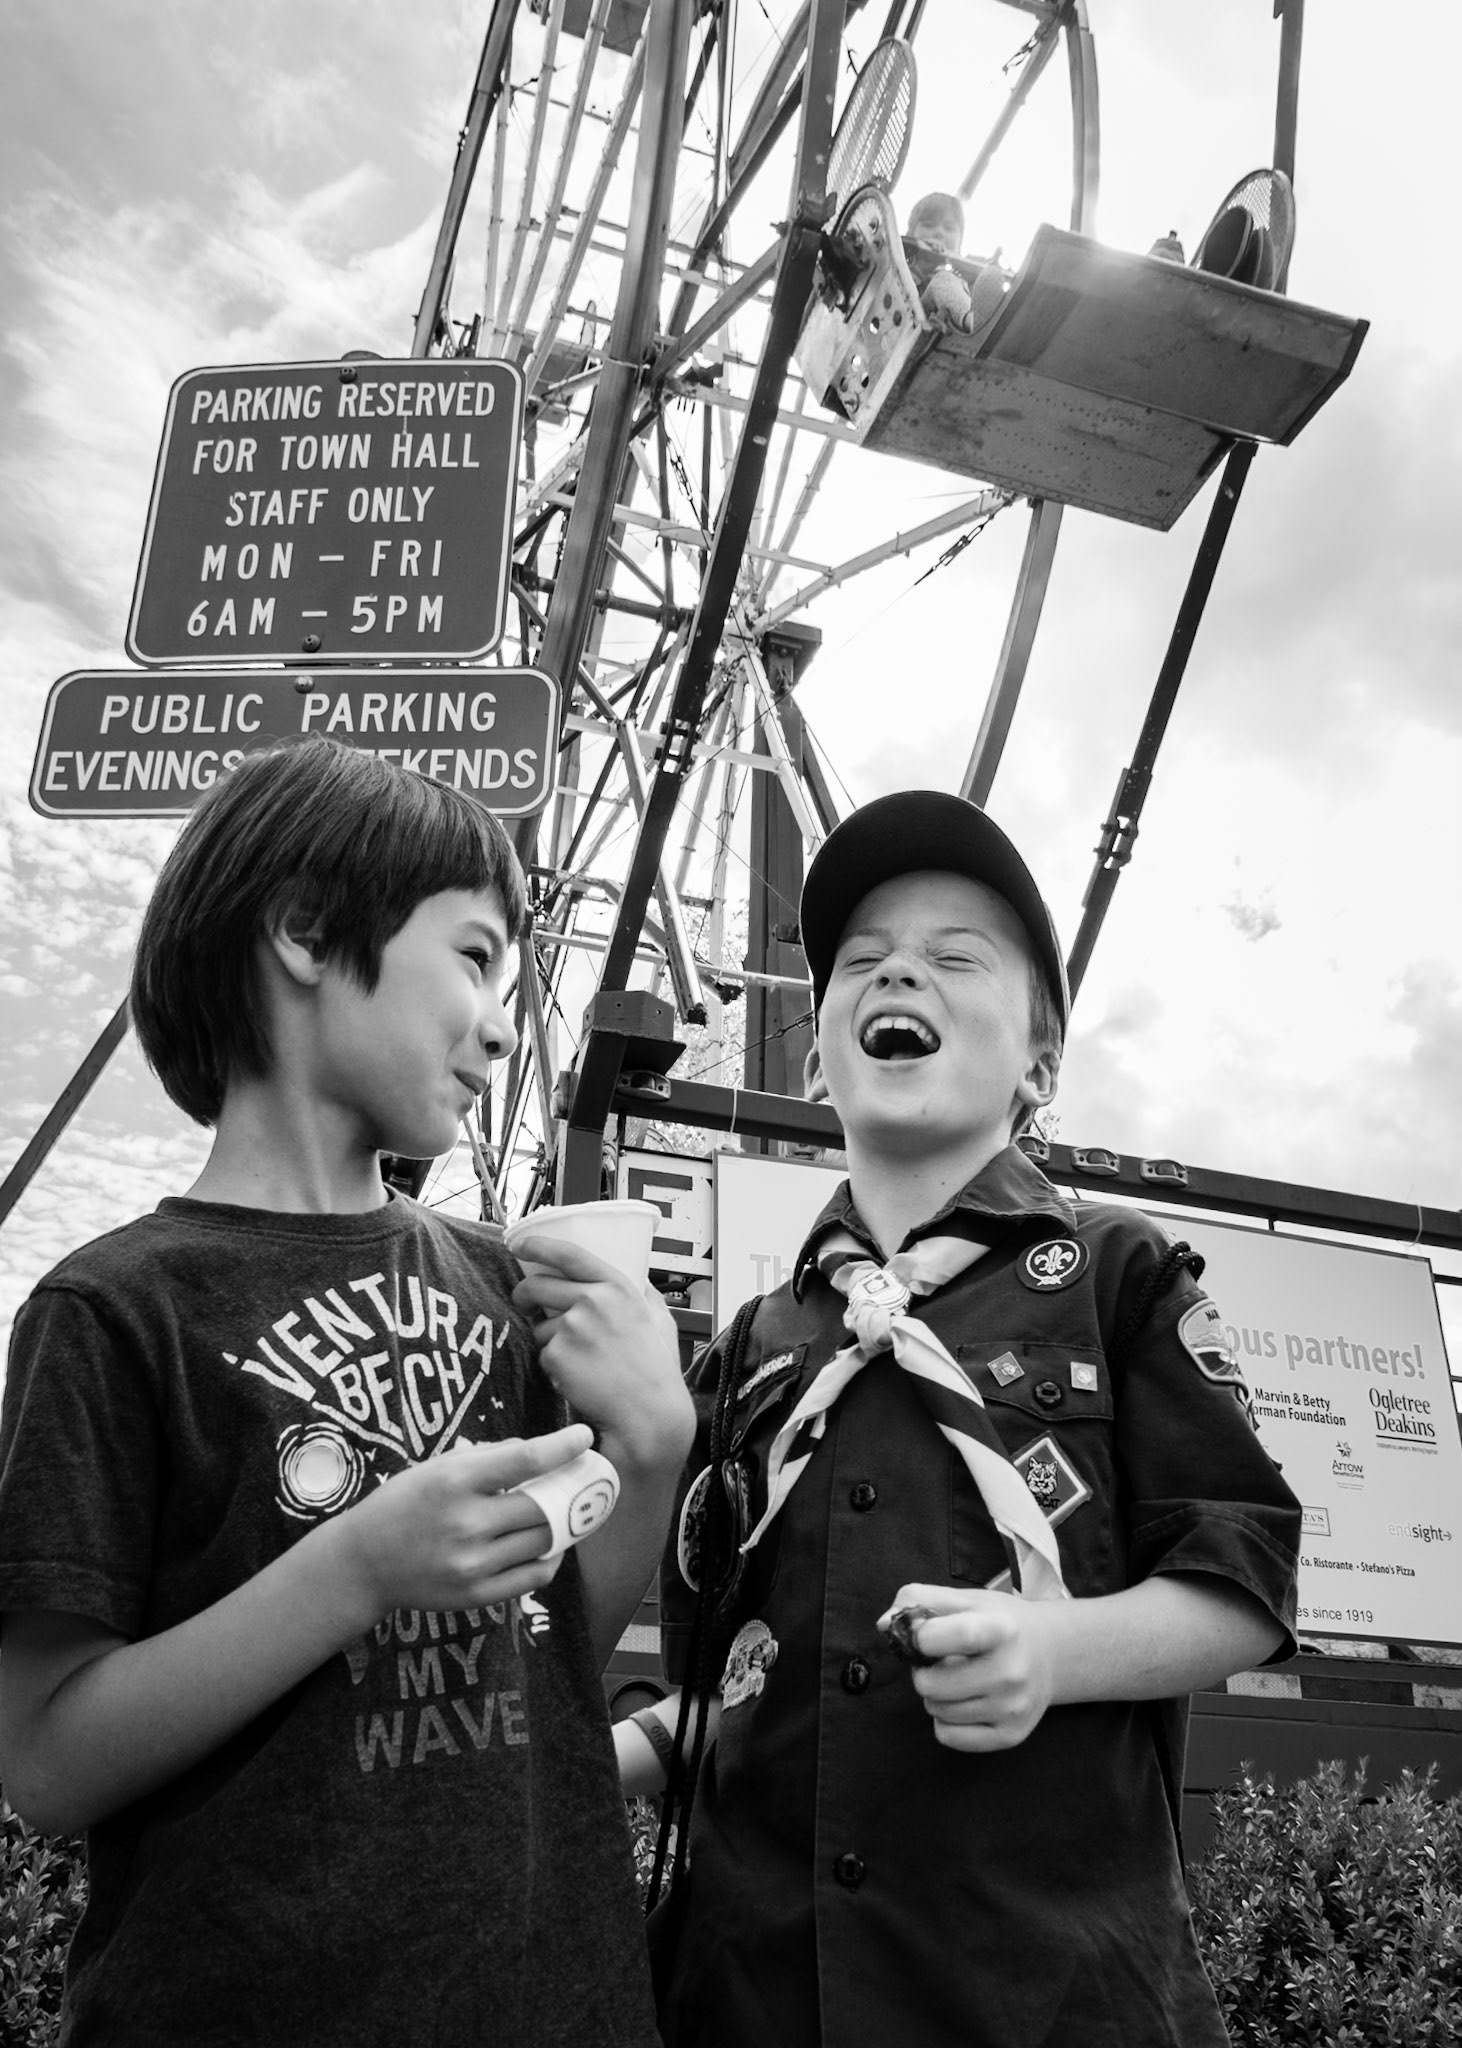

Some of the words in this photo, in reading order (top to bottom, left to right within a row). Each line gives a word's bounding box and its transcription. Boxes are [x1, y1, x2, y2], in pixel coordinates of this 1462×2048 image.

[191, 385, 323, 424] PARKING
[338, 382, 495, 417] RESERVED
[193, 438, 257, 474] FOR
[281, 434, 371, 471] TOWN
[391, 433, 480, 468] HALL
[225, 488, 329, 526] STAFF
[348, 486, 435, 523] ONLY
[201, 542, 293, 581] MON
[370, 540, 442, 577] FRI
[187, 598, 276, 637] 6AM
[350, 595, 443, 633] 5PM
[100, 694, 263, 735] PUBLIC
[301, 692, 497, 733] PARKING
[628, 1167, 712, 1258] E
[241, 1272, 493, 1402] VENTURA
[750, 1254, 793, 1293] Th
[1285, 1333, 1425, 1379] partners!
[1254, 1387, 1290, 1404] Marvin
[1293, 1392, 1301, 1405] &
[1303, 1394, 1330, 1411] Betty
[1254, 1405, 1287, 1419] orman
[1288, 1407, 1346, 1426] Foundation
[1369, 1387, 1431, 1414] Ogletree
[1375, 1410, 1435, 1437] Deakins
[1313, 1557, 1353, 1571] Ristorante
[1361, 1562, 1395, 1575] Stefano's
[1396, 1565, 1415, 1577] Pizza
[1312, 1606, 1342, 1620] since
[1346, 1609, 1374, 1623] 1919
[397, 1634, 486, 1699] MY
[354, 1690, 530, 1772] WAVE
